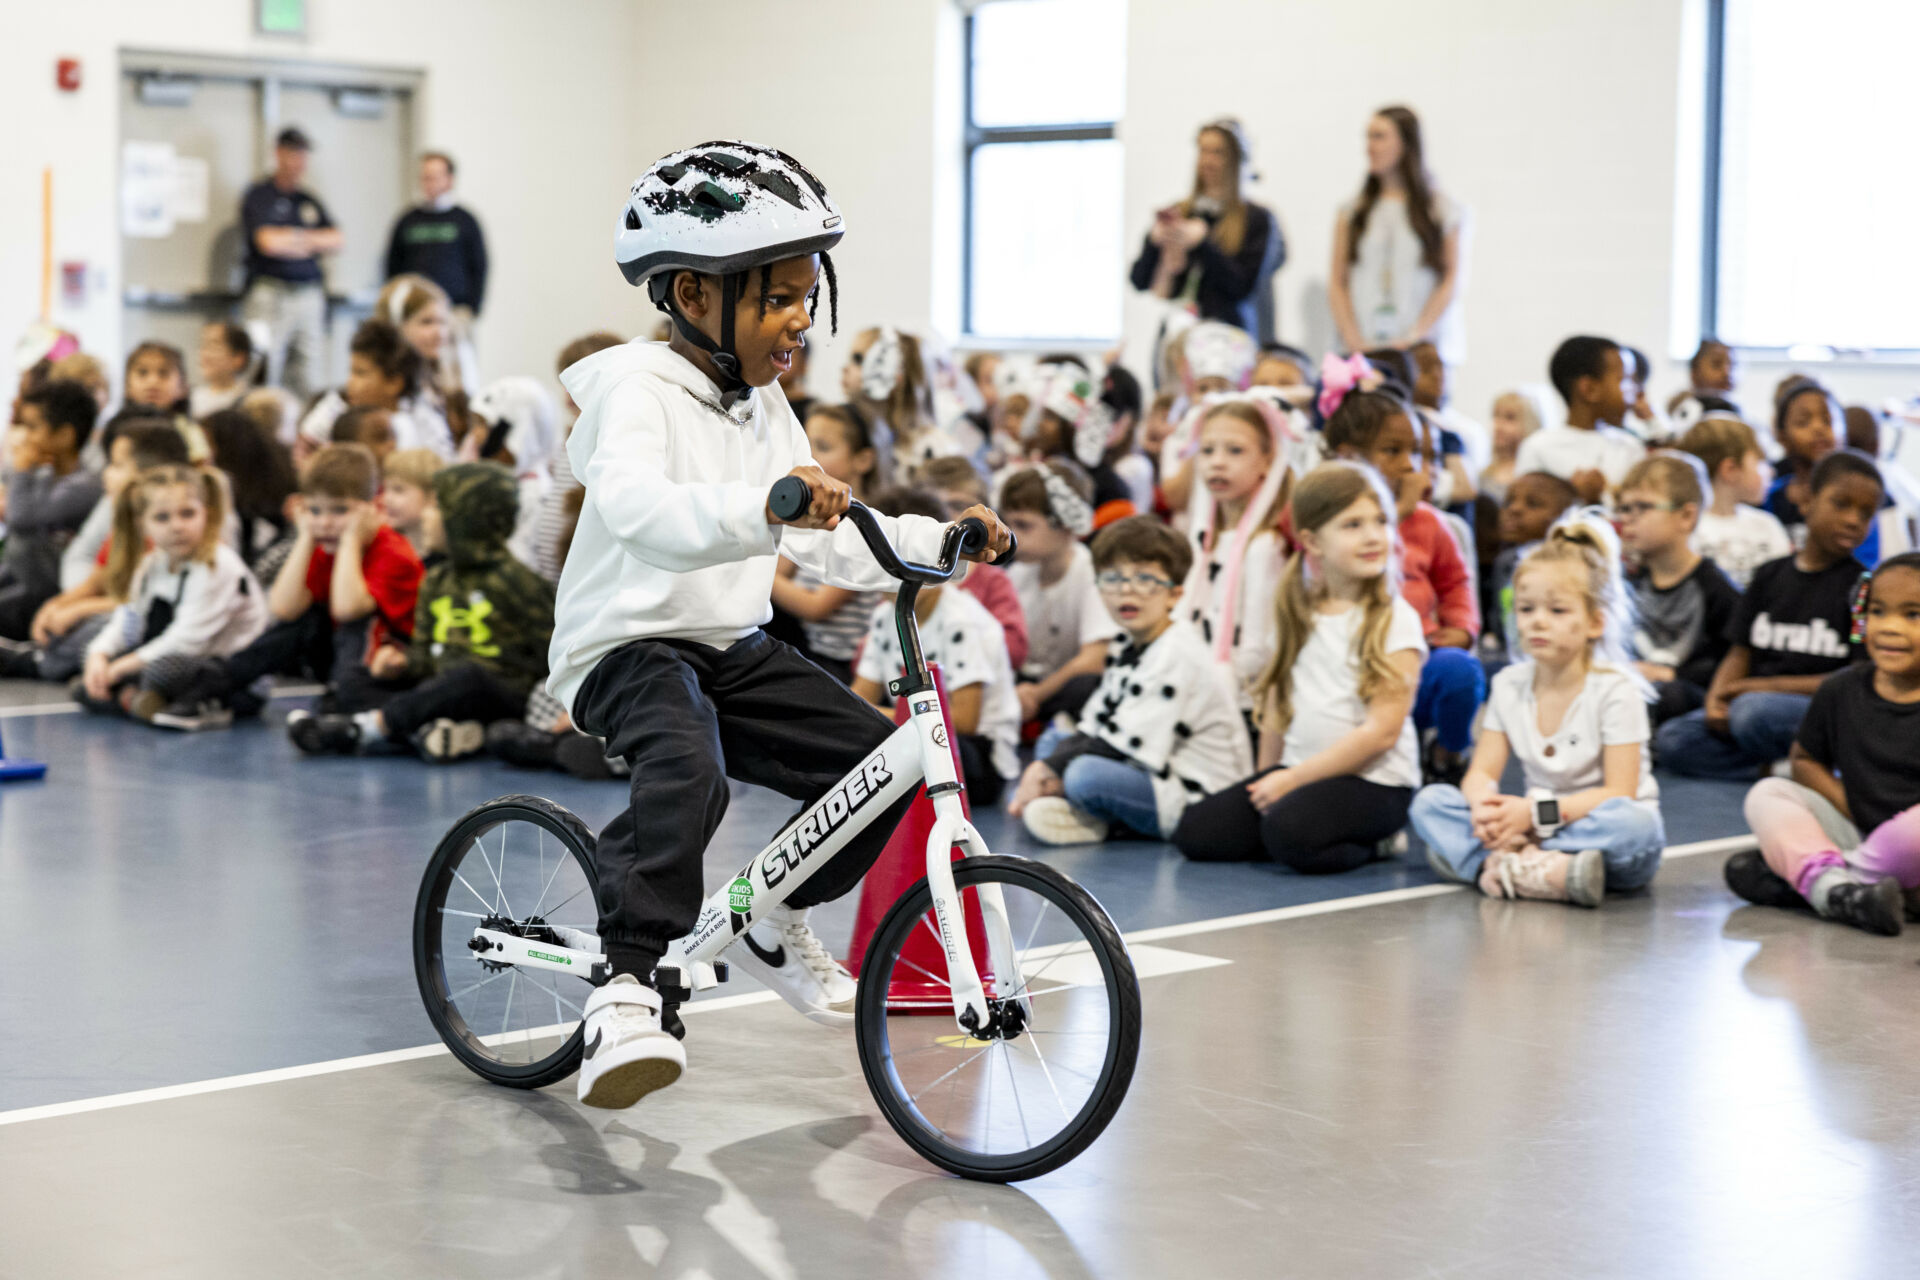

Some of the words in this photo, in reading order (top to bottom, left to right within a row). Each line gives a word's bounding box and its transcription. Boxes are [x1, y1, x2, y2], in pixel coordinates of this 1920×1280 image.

[761, 752, 893, 890] STRIDER
[729, 894, 752, 906] BIKE
[734, 884, 751, 895] KIDS
[684, 942, 701, 956] MAKE
[699, 931, 711, 943] LIFE
[714, 917, 727, 930] RIDE
